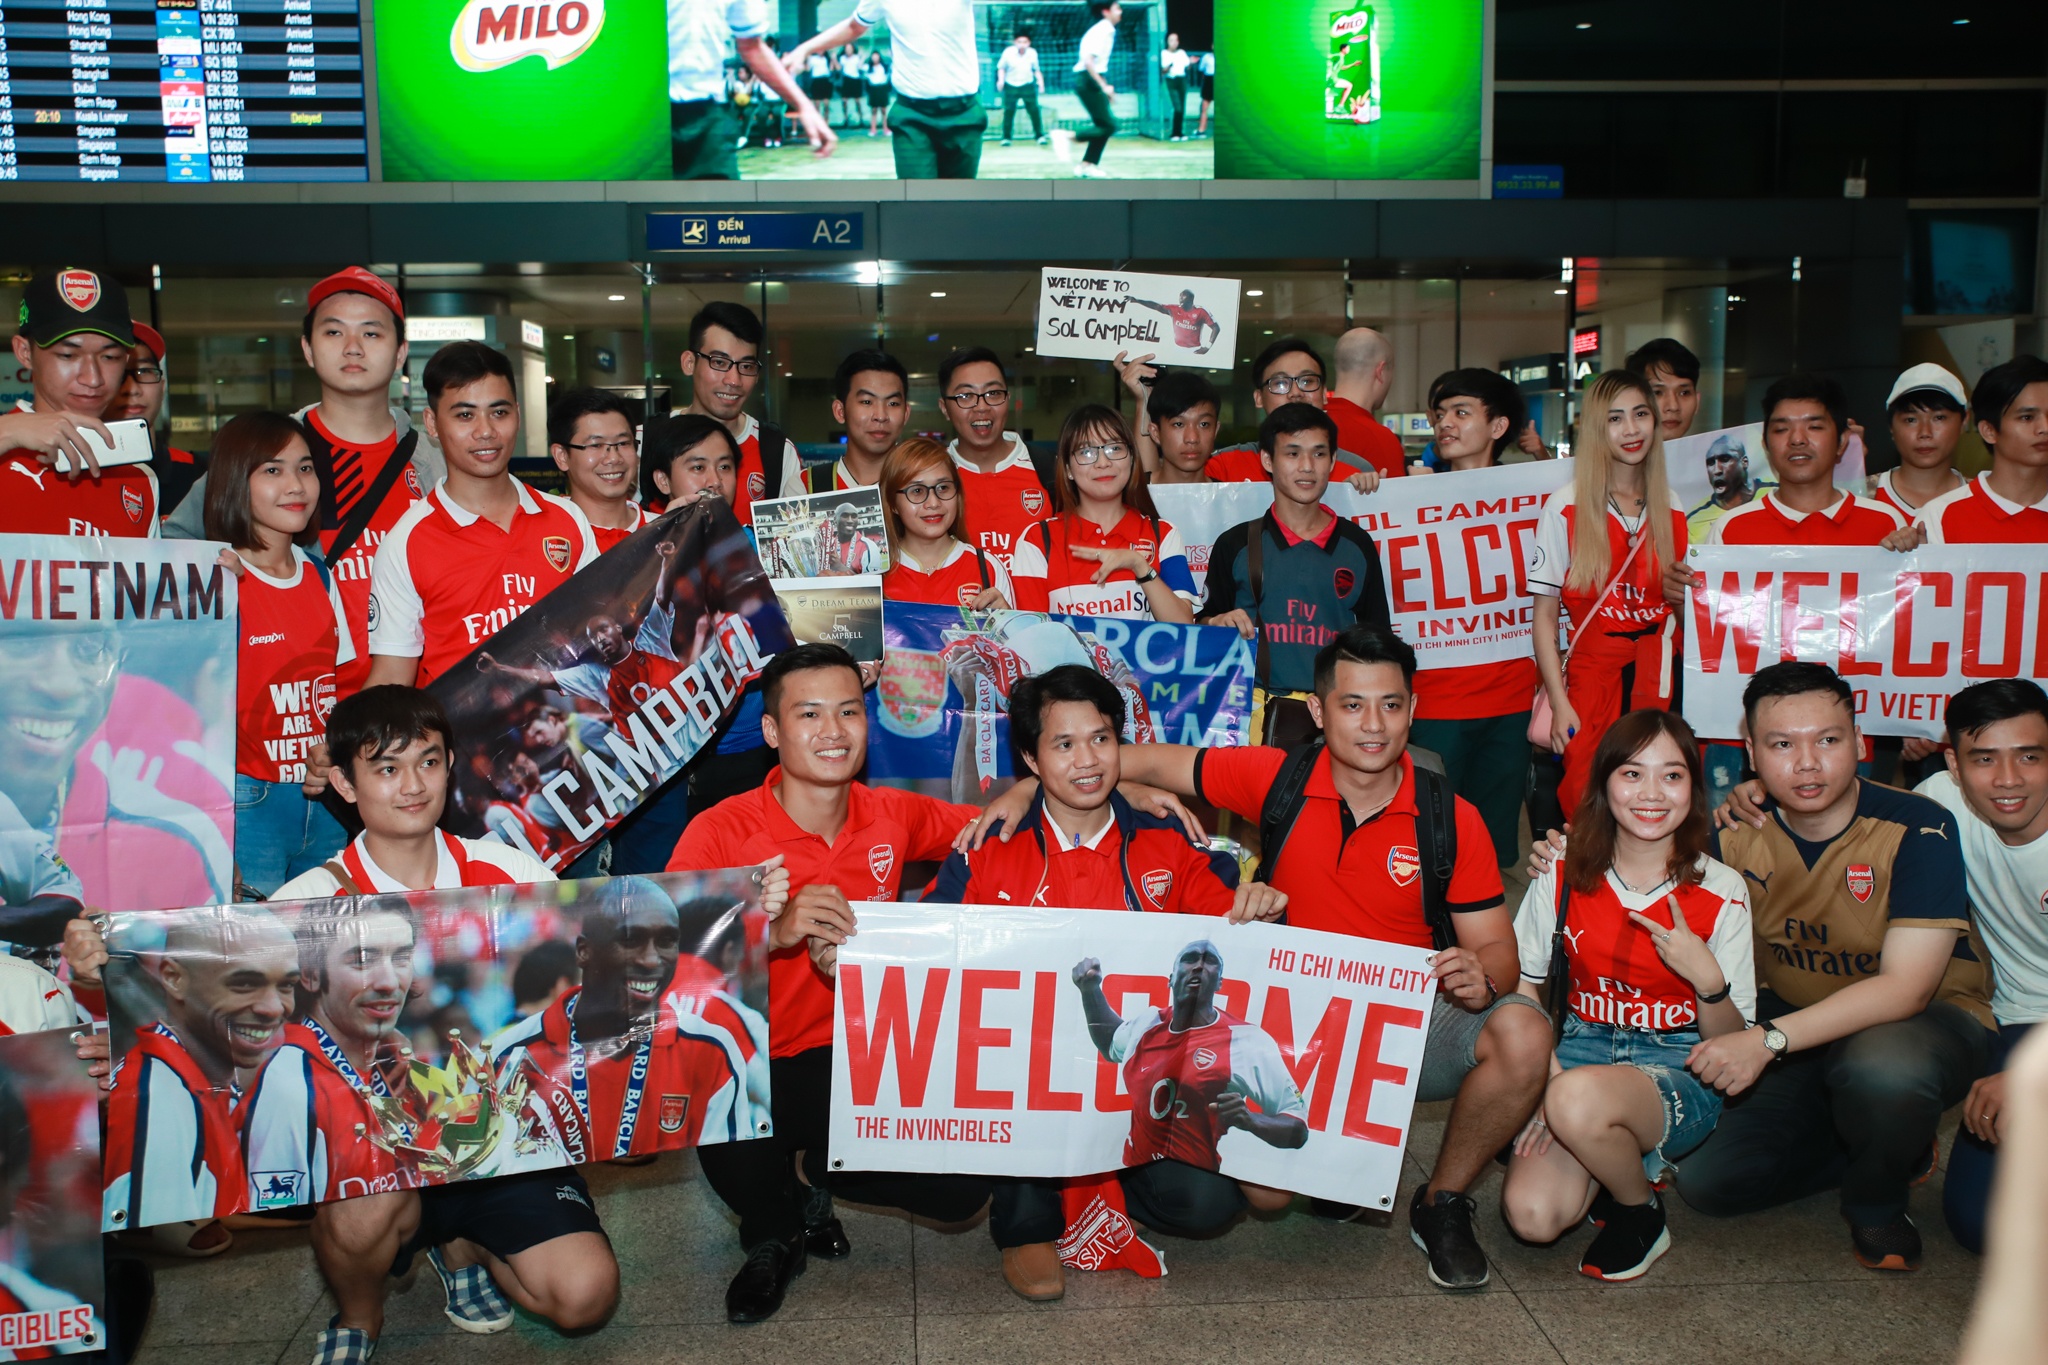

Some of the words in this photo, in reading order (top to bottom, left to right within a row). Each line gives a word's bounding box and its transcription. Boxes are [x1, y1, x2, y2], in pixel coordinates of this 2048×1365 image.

[284, 0, 311, 11] Arrived
[67, 10, 88, 24] Hong
[89, 11, 110, 25] Kong
[201, 13, 216, 25] VN
[285, 14, 312, 25] Arrived
[476, 1, 589, 45] MILO
[68, 25, 89, 39] Hong
[91, 26, 112, 39] Kong
[286, 28, 313, 39] Arrived
[70, 40, 107, 53] Shanghai
[204, 42, 219, 54] MU
[287, 42, 314, 53] Arrived
[71, 54, 110, 67] Singapore
[205, 56, 220, 68] SQ
[288, 56, 315, 67] Arrived
[72, 68, 109, 82] Shanghai
[205, 70, 220, 82] VN
[289, 70, 316, 81] Arrived
[73, 82, 97, 94] Dubai
[206, 84, 221, 97] EK
[289, 84, 317, 95] Arrived
[74, 96, 95, 108] Siem
[96, 96, 117, 110] Reap
[75, 111, 98, 122] Kuala
[99, 112, 128, 124] Lumpur
[208, 112, 223, 124] AK
[291, 112, 322, 126] Delayed
[76, 125, 116, 138] Singapore
[78, 139, 117, 152] Singapore
[79, 153, 100, 165] Siem
[100, 153, 122, 167] Reap
[211, 154, 226, 167] VN
[80, 167, 119, 181] Singapore
[212, 168, 227, 181] VN
[718, 217, 744, 231] ĐẾN
[812, 220, 851, 244] A2
[719, 235, 751, 245] Arrival
[65, 277, 94, 286] Arsenal
[1047, 276, 1110, 291] WELCOME
[1114, 280, 1130, 292] TO
[1088, 297, 1128, 314] NAM
[124, 489, 142, 502] Arsenal
[1351, 512, 1401, 531] OL
[979, 531, 1011, 551] Fly
[1375, 519, 1538, 614] ELCO
[503, 573, 535, 597] Fly
[1612, 582, 1646, 603] Fly
[811, 599, 845, 608] DREAM
[850, 597, 876, 606] TEAM
[1287, 599, 1317, 621] Fly
[832, 624, 849, 633] SOL
[1691, 571, 2048, 678] WELCO
[819, 631, 863, 641] CAMPBELL
[1425, 641, 1442, 649] CHI
[1445, 638, 1471, 648] MINH
[1473, 635, 1493, 645] CITY
[269, 680, 310, 715] WE
[282, 714, 312, 736] ARE
[541, 613, 776, 843] CAMPBELL
[980, 679, 991, 764] BARCLAYCARD
[872, 850, 890, 861] Arsenal
[1394, 851, 1419, 863] Arsenal
[1147, 873, 1169, 884] Arsenal
[877, 885, 885, 894] Fly
[1784, 917, 1827, 945] Fly
[1269, 948, 1294, 973] HO
[1300, 953, 1334, 976] CHI
[1337, 959, 1391, 987] MINH
[1394, 967, 1433, 995] CITY
[1598, 976, 1642, 998] Fly
[1149, 1078, 1190, 1120] O2
[1671, 1091, 1685, 1126] FILA
[855, 1116, 891, 1140] THE
[896, 1118, 1012, 1144] INVINCIBLES
